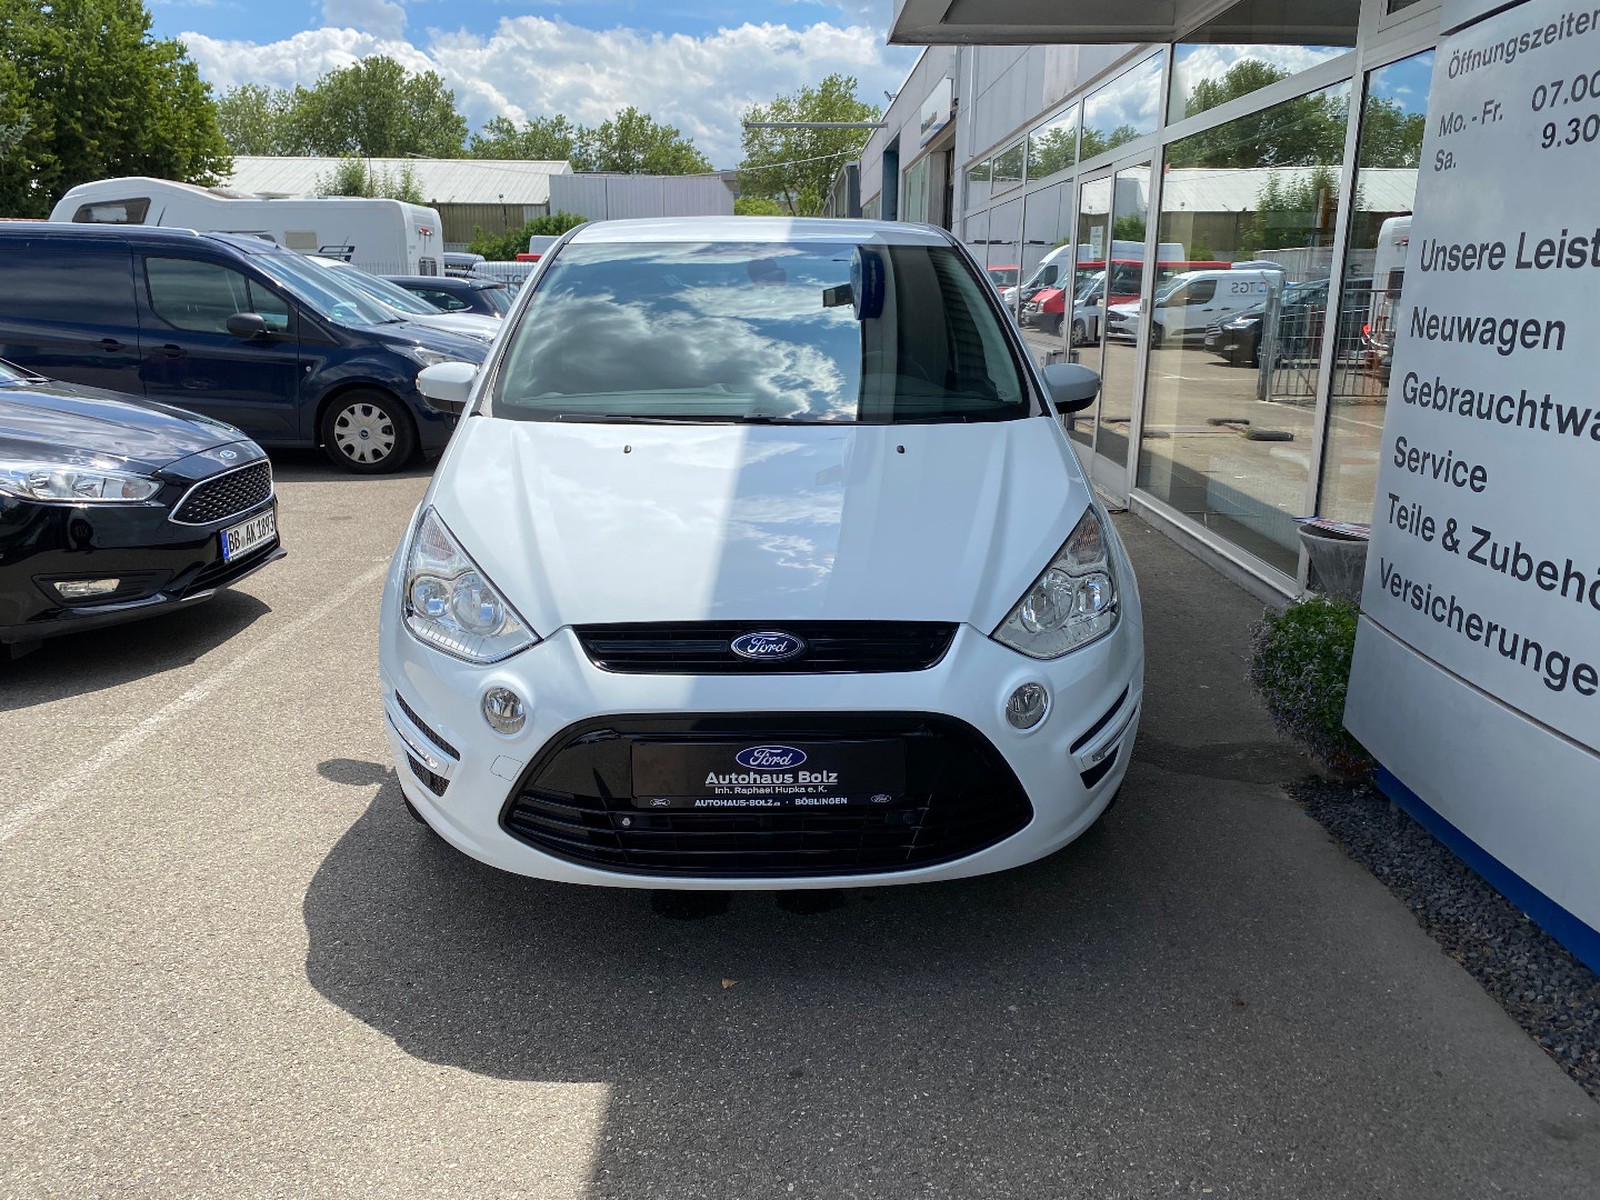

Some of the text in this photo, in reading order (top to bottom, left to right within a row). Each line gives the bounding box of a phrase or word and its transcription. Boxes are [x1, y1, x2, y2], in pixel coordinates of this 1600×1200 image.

[1438, 114, 1467, 137] Mo.
[1481, 99, 1503, 126] Fr.
[1434, 113, 1600, 172] Sa. 9.30
[1420, 239, 1506, 272] Unsere
[1410, 306, 1566, 356] Neuwagen
[1393, 435, 1488, 493] Service
[1388, 492, 1436, 542] Teile
[1441, 518, 1460, 555] &
[228, 529, 241, 553] BB
[1380, 557, 1599, 697] Versicherunge
[747, 637, 788, 653] Ford
[749, 748, 793, 766] Ford
[705, 770, 839, 784] Autohaus Bolz
[734, 786, 774, 796] Raphael
[775, 786, 806, 794] Hupka
[818, 785, 828, 793] K.
[795, 797, 848, 806] BÖBLINGEN
